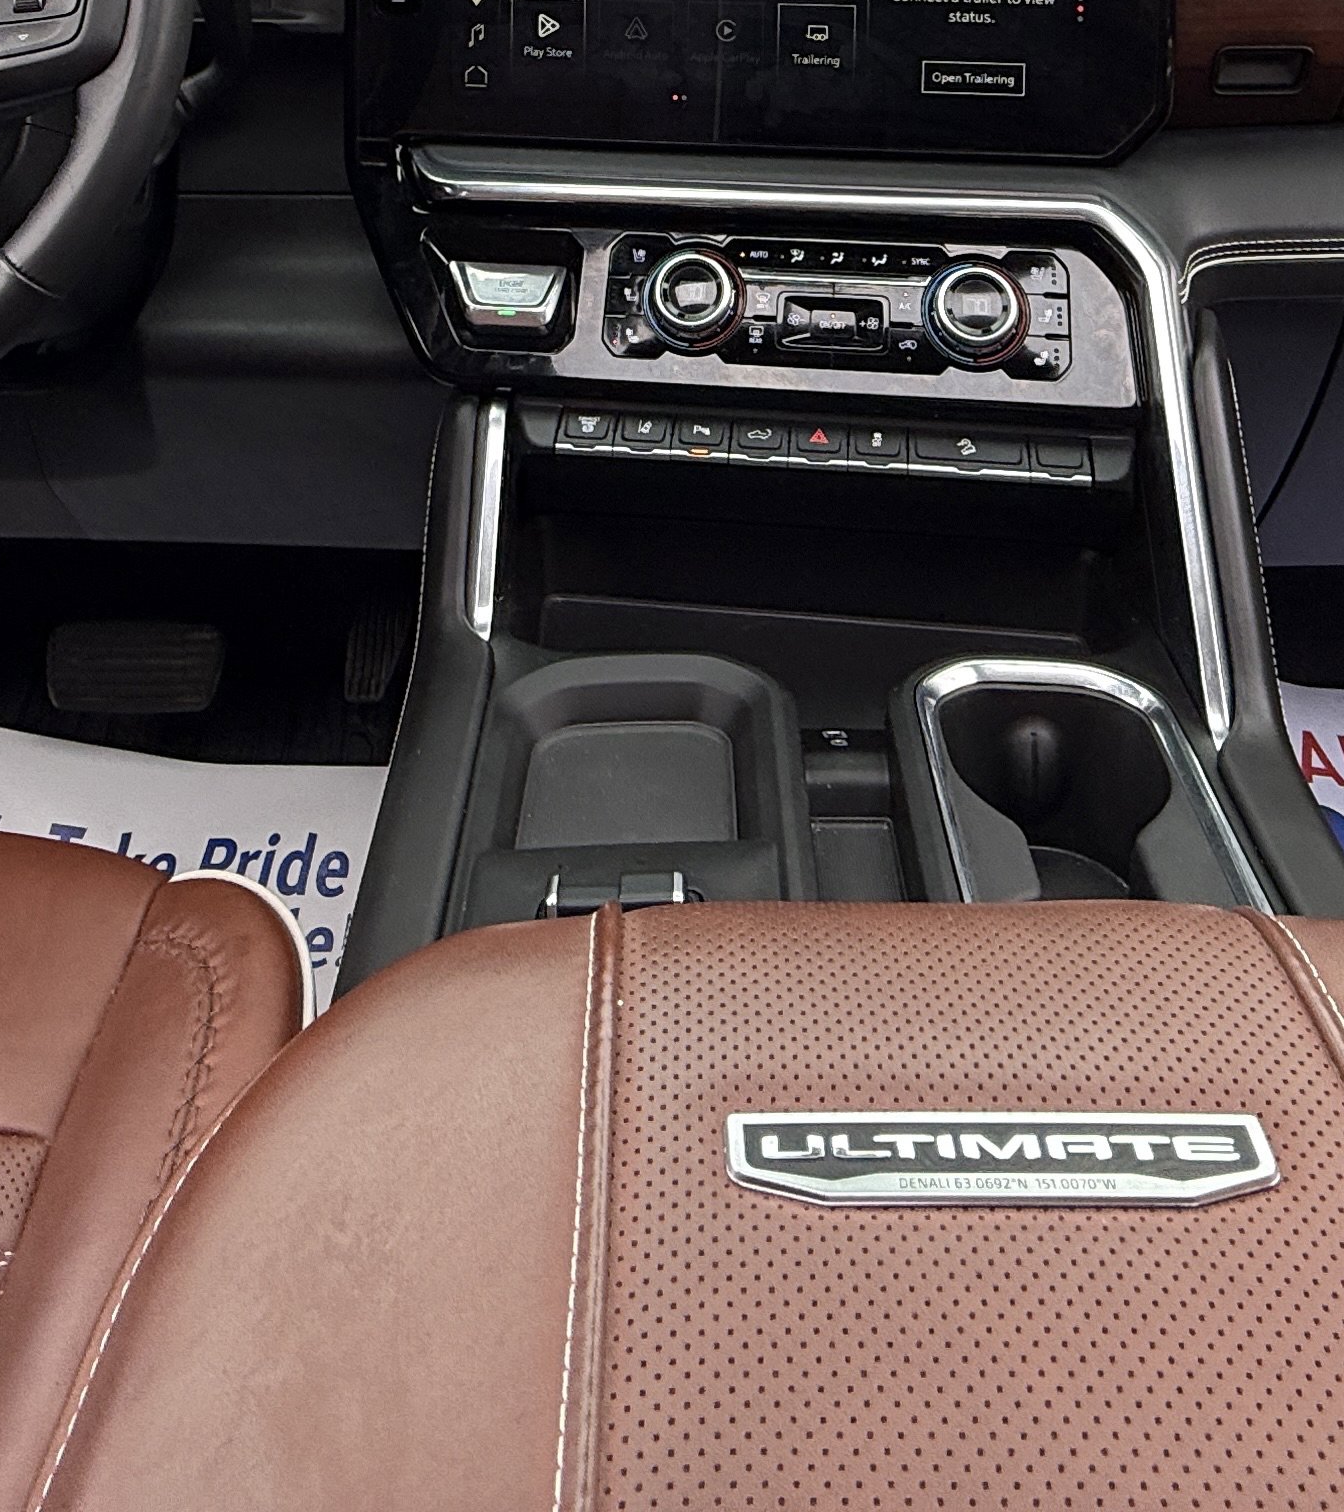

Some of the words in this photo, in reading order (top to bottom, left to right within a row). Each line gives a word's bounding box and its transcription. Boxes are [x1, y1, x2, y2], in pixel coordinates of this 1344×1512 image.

[948, 11, 996, 24] status.
[523, 45, 544, 59] Play
[546, 47, 573, 58] Store
[792, 53, 840, 68] Trailering
[932, 72, 963, 85] Open
[964, 73, 1015, 87] Trailering
[749, 251, 768, 259] AUTO
[911, 258, 931, 266] SYNC
[899, 302, 912, 310] A/C
[819, 320, 846, 330] ON/OFF
[199, 832, 351, 898] Pride
[761, 1133, 1241, 1162] ULTIMATE
[899, 1177, 951, 1189] DENALI
